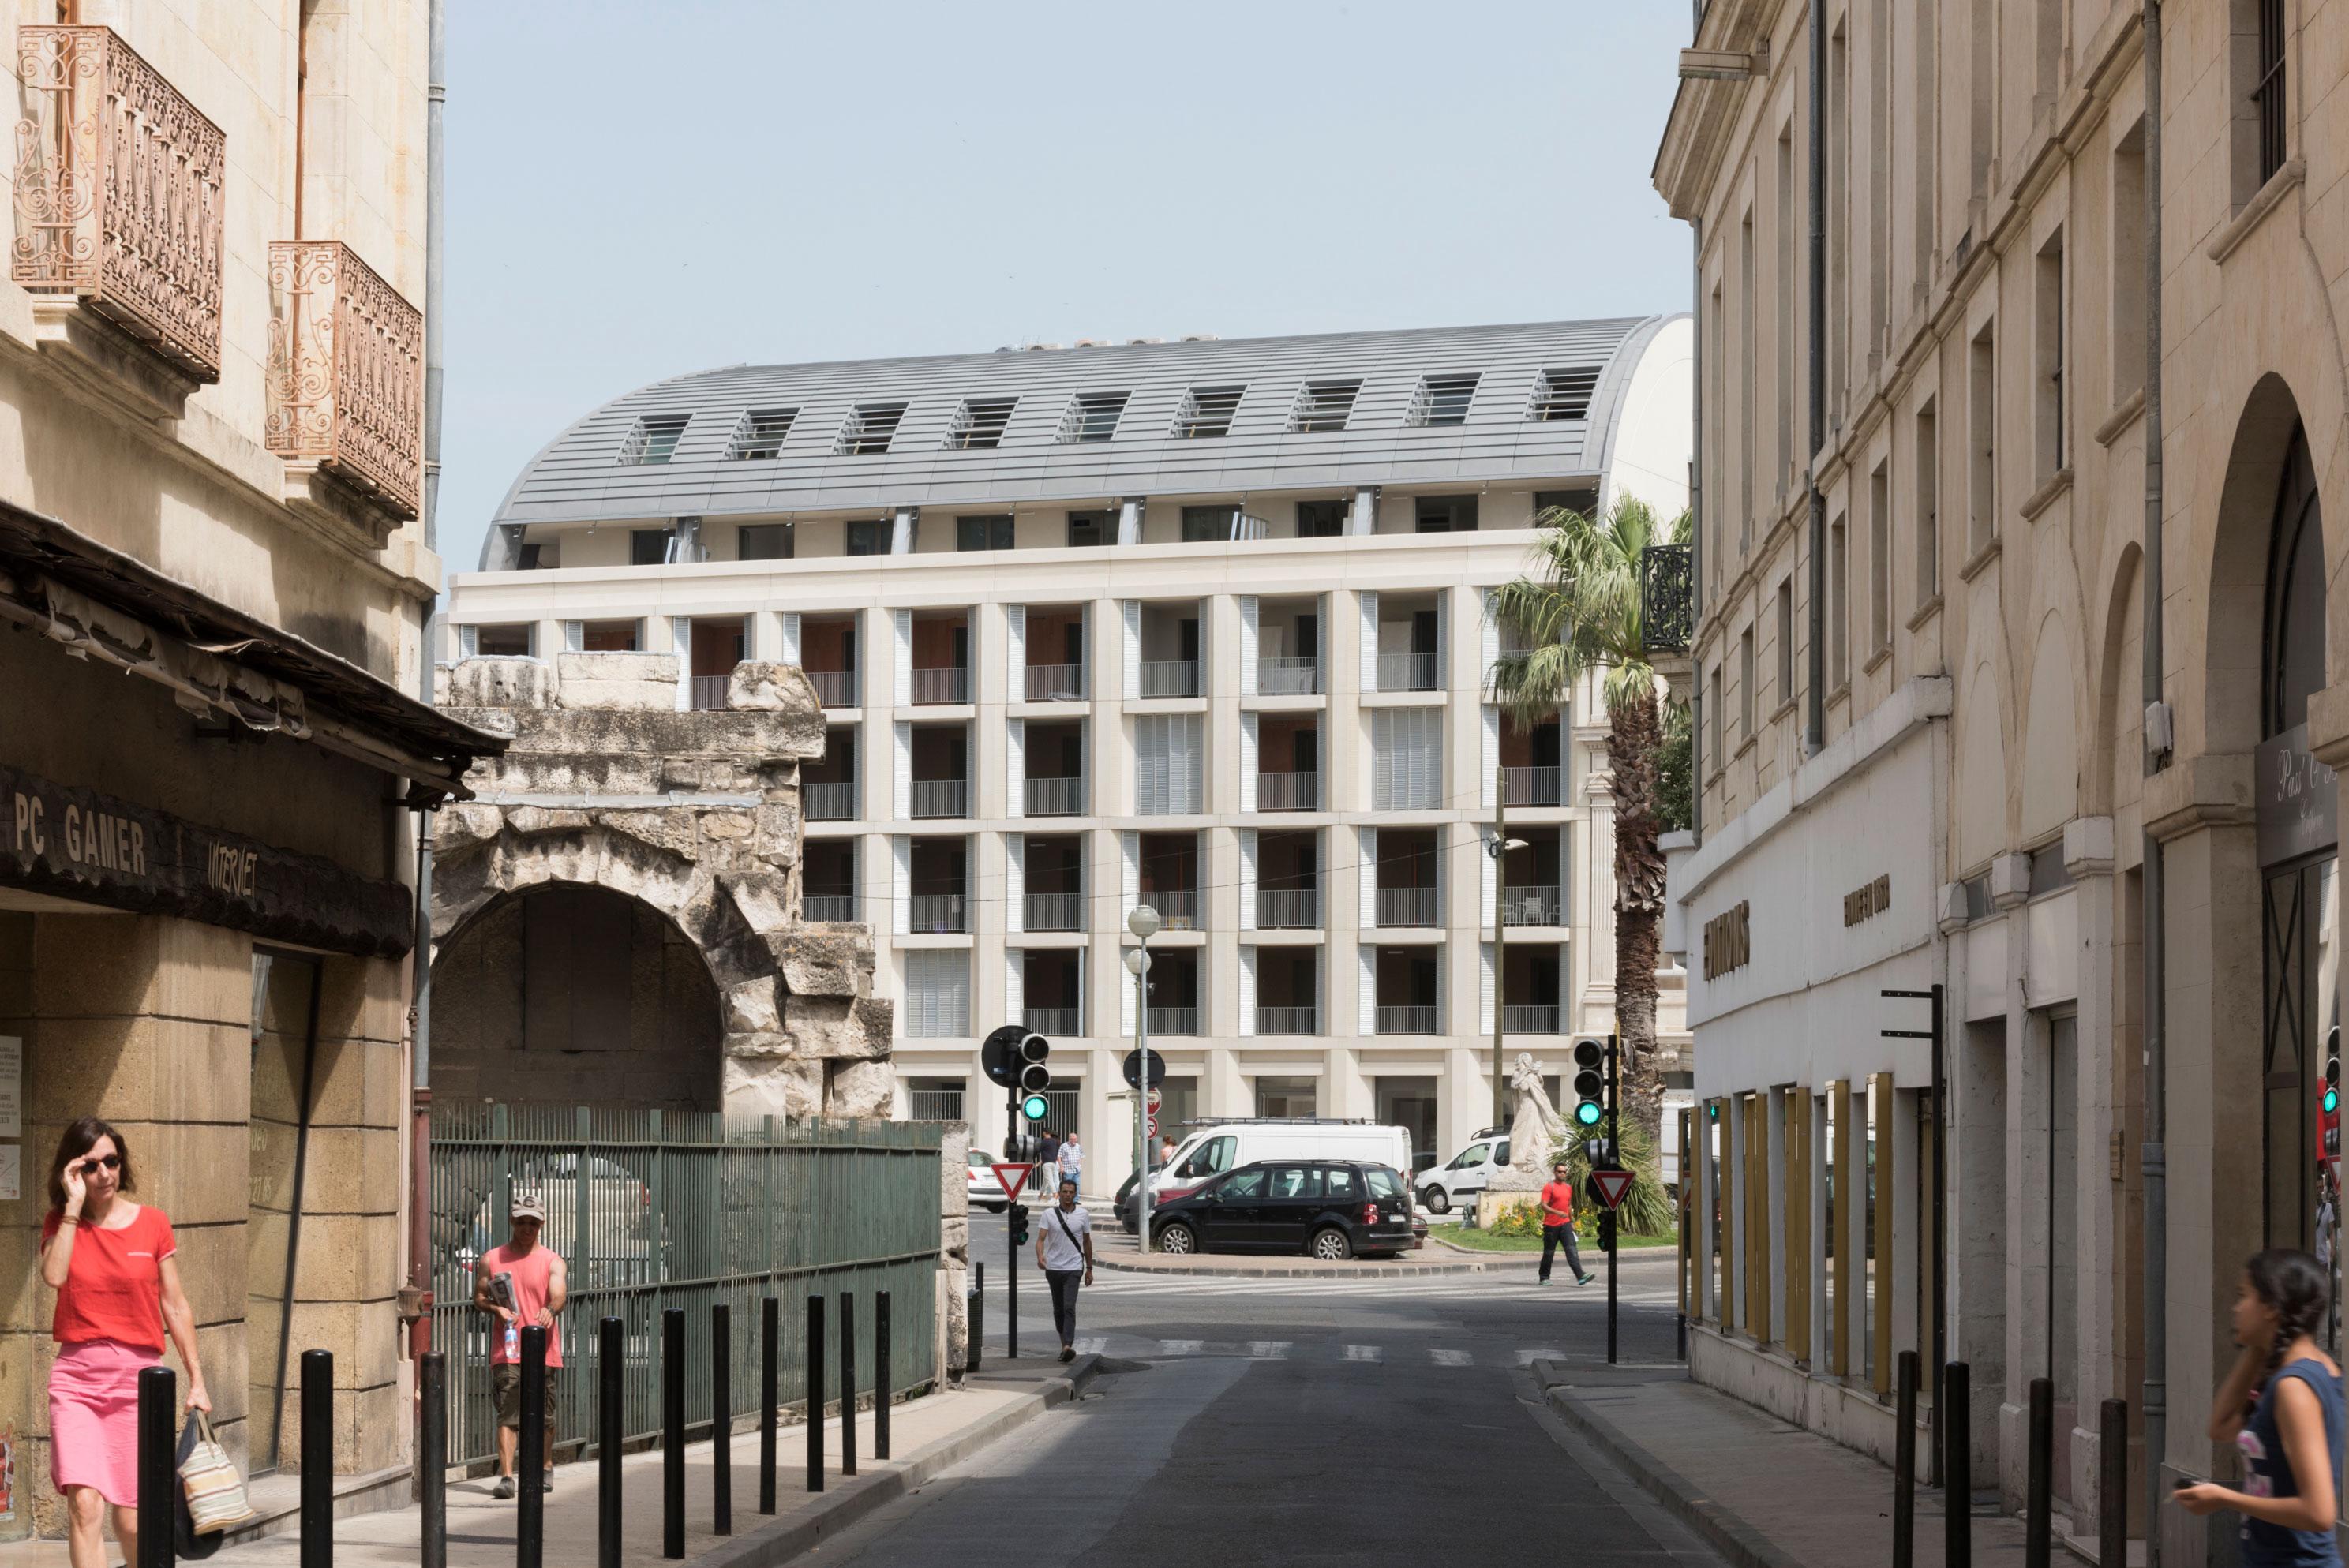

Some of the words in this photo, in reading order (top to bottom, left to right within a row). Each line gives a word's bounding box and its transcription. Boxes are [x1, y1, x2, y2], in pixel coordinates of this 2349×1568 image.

[15, 792, 45, 855] PC
[65, 804, 146, 876] GAMER
[208, 840, 257, 897] INTERNET
